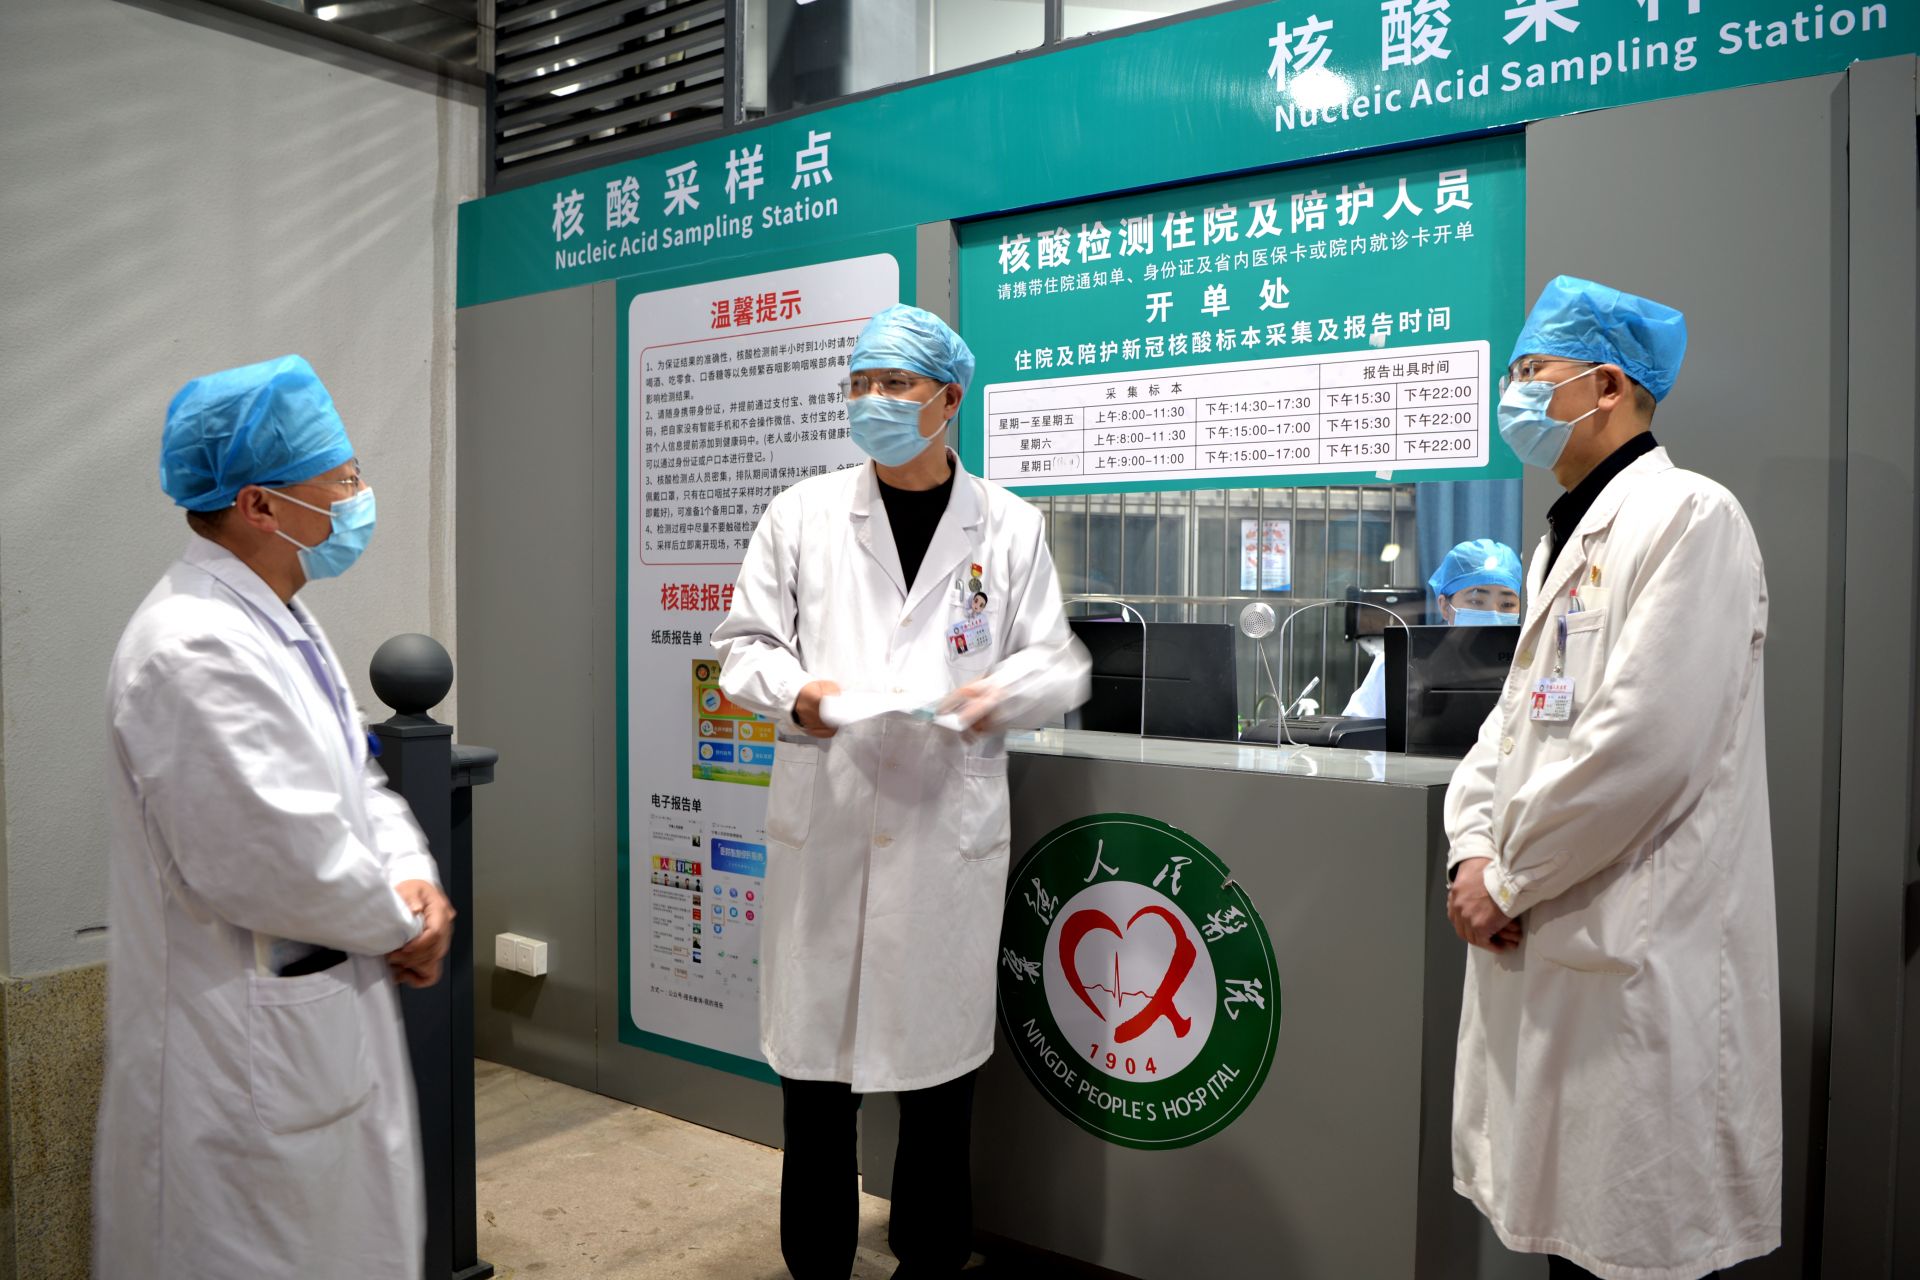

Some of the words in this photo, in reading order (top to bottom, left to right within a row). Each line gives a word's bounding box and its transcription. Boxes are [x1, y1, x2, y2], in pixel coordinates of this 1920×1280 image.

[1274, 83, 1401, 132] Nucleic
[1409, 64, 1490, 108] Acid
[1500, 34, 1697, 92] Sampling
[1718, 2, 1887, 56] Station
[552, 129, 833, 242] 核酸采样点
[555, 239, 617, 270] Nucleic
[620, 224, 658, 256] Acid
[662, 211, 753, 249] Sampling
[762, 194, 838, 229] Station
[998, 168, 1473, 275] 核酸检测住院及陪护人员
[997, 221, 1475, 301] 请携带住院通知单、身份证及省内医保卡或院内就诊卡开单
[710, 289, 802, 329] 温馨提示
[1146, 277, 1290, 324] 开单处
[1014, 306, 1452, 372] 住院及陪护新冠核酸标本采集及报告时间
[1105, 381, 1183, 400] 采集标本
[1362, 359, 1450, 380] 报告出具时间
[999, 414, 1074, 430] 星期一至星期五
[1326, 390, 1391, 407] 下午15:30
[1404, 385, 1472, 403] 下午22:00
[1020, 438, 1052, 450] 星期六
[1326, 415, 1391, 432] 下午15:30
[1404, 411, 1472, 428] 下午22:00
[1020, 460, 1051, 472] 星期日
[1326, 440, 1391, 458] 下午15:30
[1404, 436, 1472, 453] 下午22:00
[661, 583, 735, 612] 核酸报告
[651, 629, 702, 645] 纸质报告单
[651, 793, 702, 813] 电子报告单
[1022, 1018, 1076, 1088] NINGDE
[1078, 1079, 1157, 1121] PEOPLE'S
[1162, 1063, 1241, 1120] HOSPITAL
[1089, 1043, 1157, 1075] 1904
